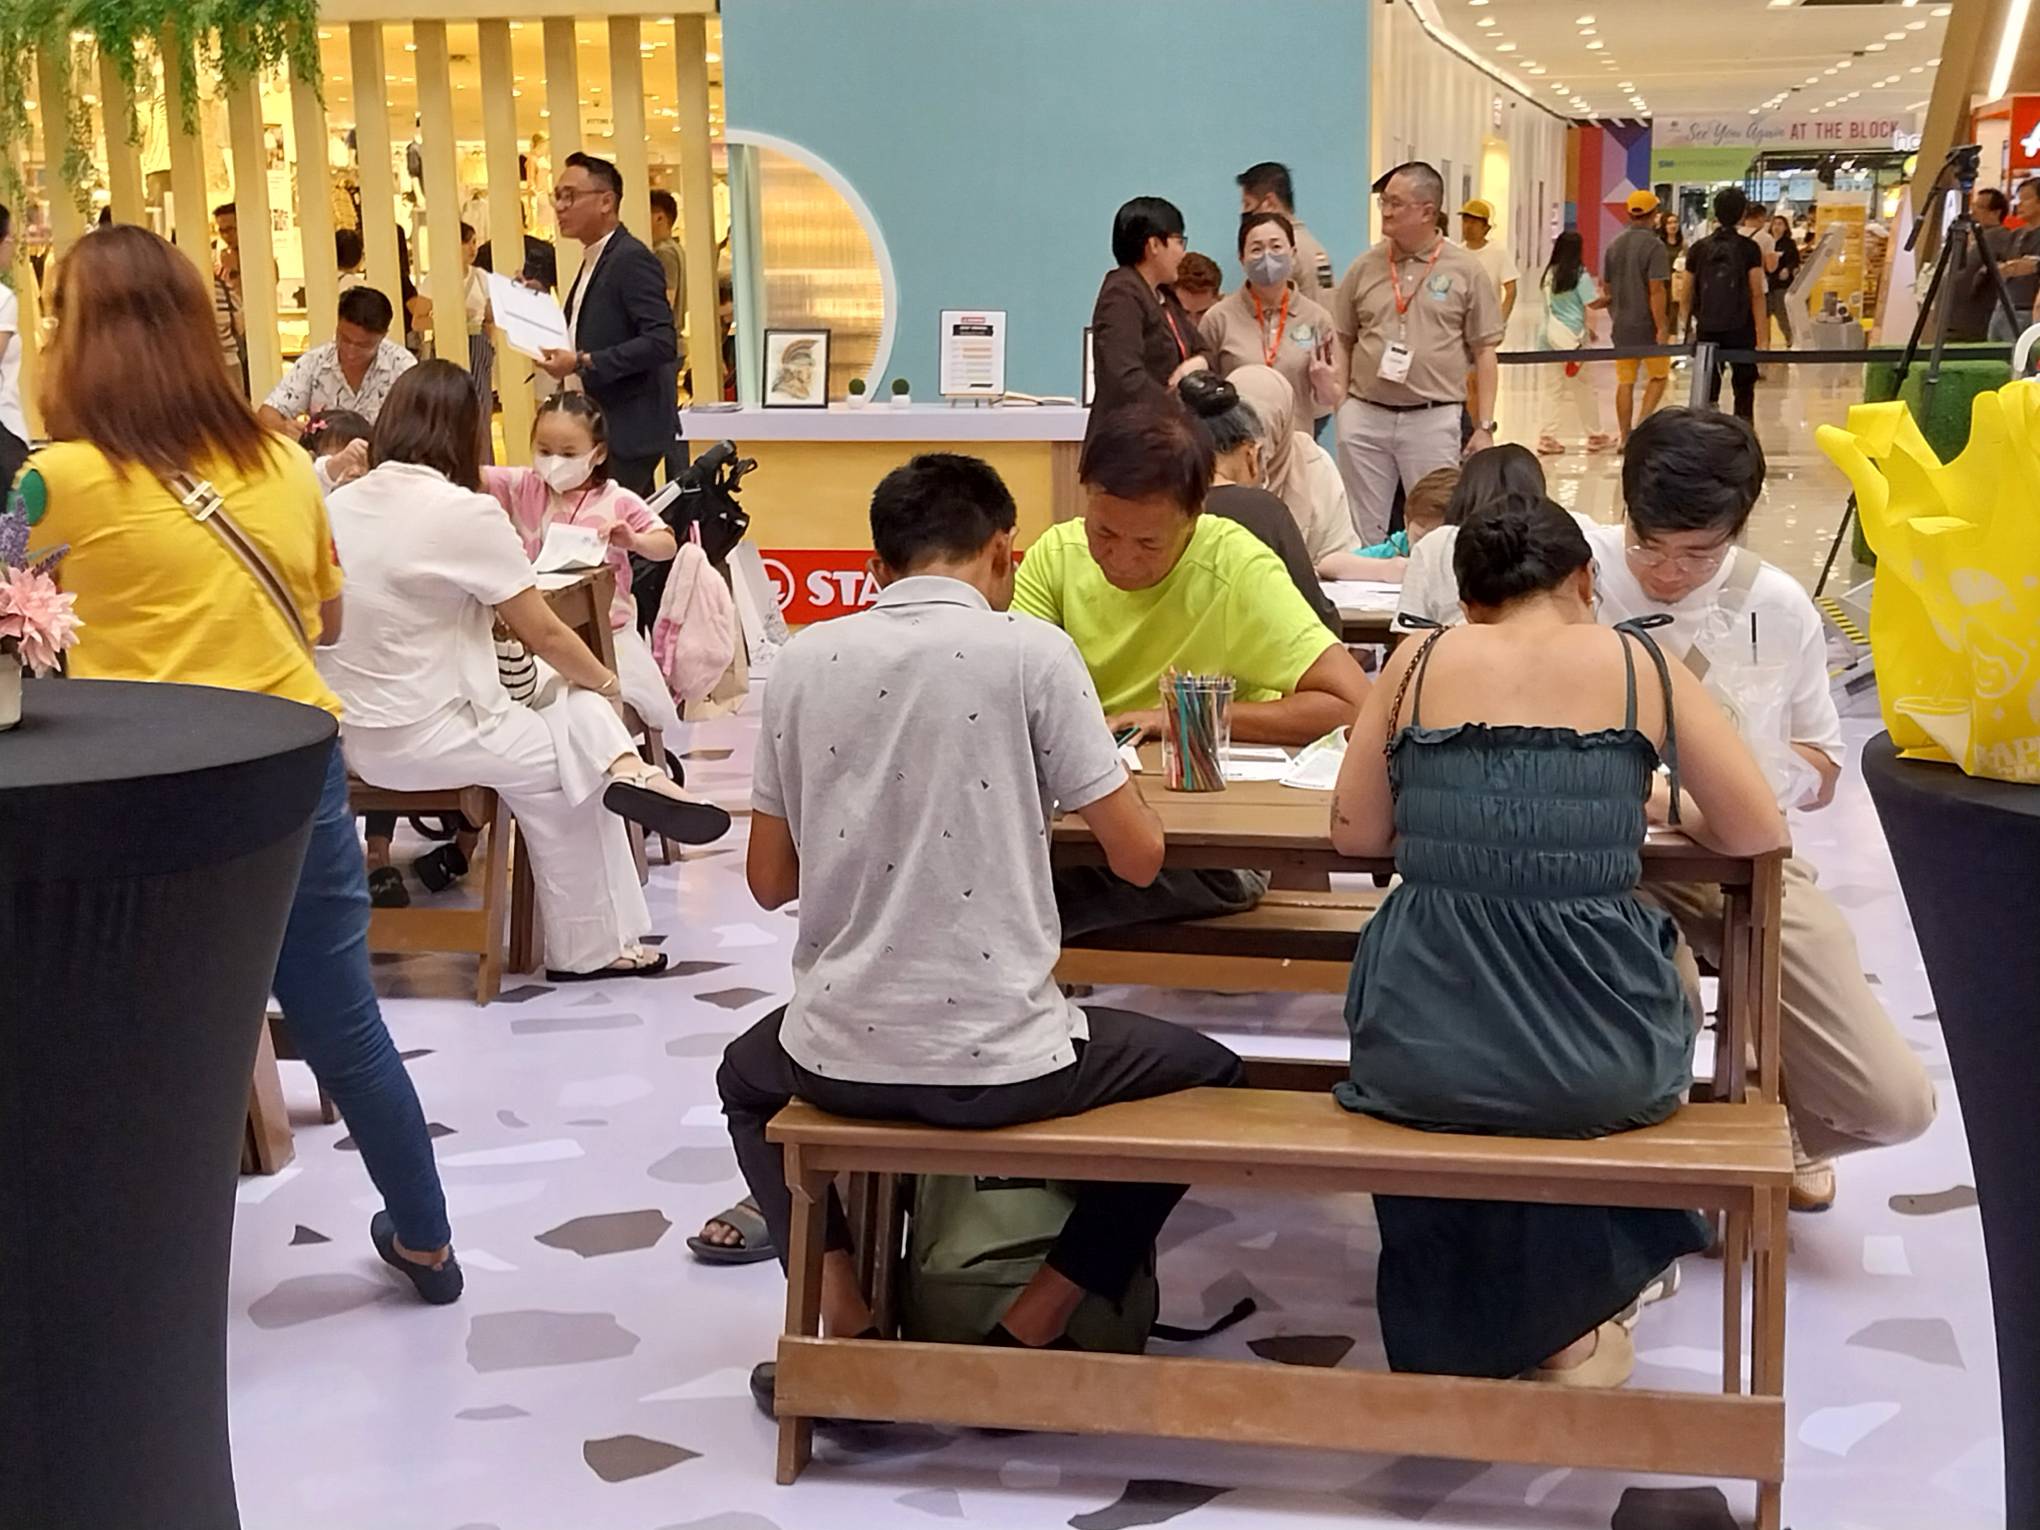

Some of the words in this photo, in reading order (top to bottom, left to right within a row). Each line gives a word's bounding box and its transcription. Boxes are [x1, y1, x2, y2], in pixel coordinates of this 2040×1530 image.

[1686, 122, 1709, 142] See
[1712, 122, 1741, 146] You
[1745, 121, 1785, 146] Again
[1790, 123, 1807, 140] AT
[1815, 122, 1843, 139] THE
[1850, 120, 1899, 139] BLOCK
